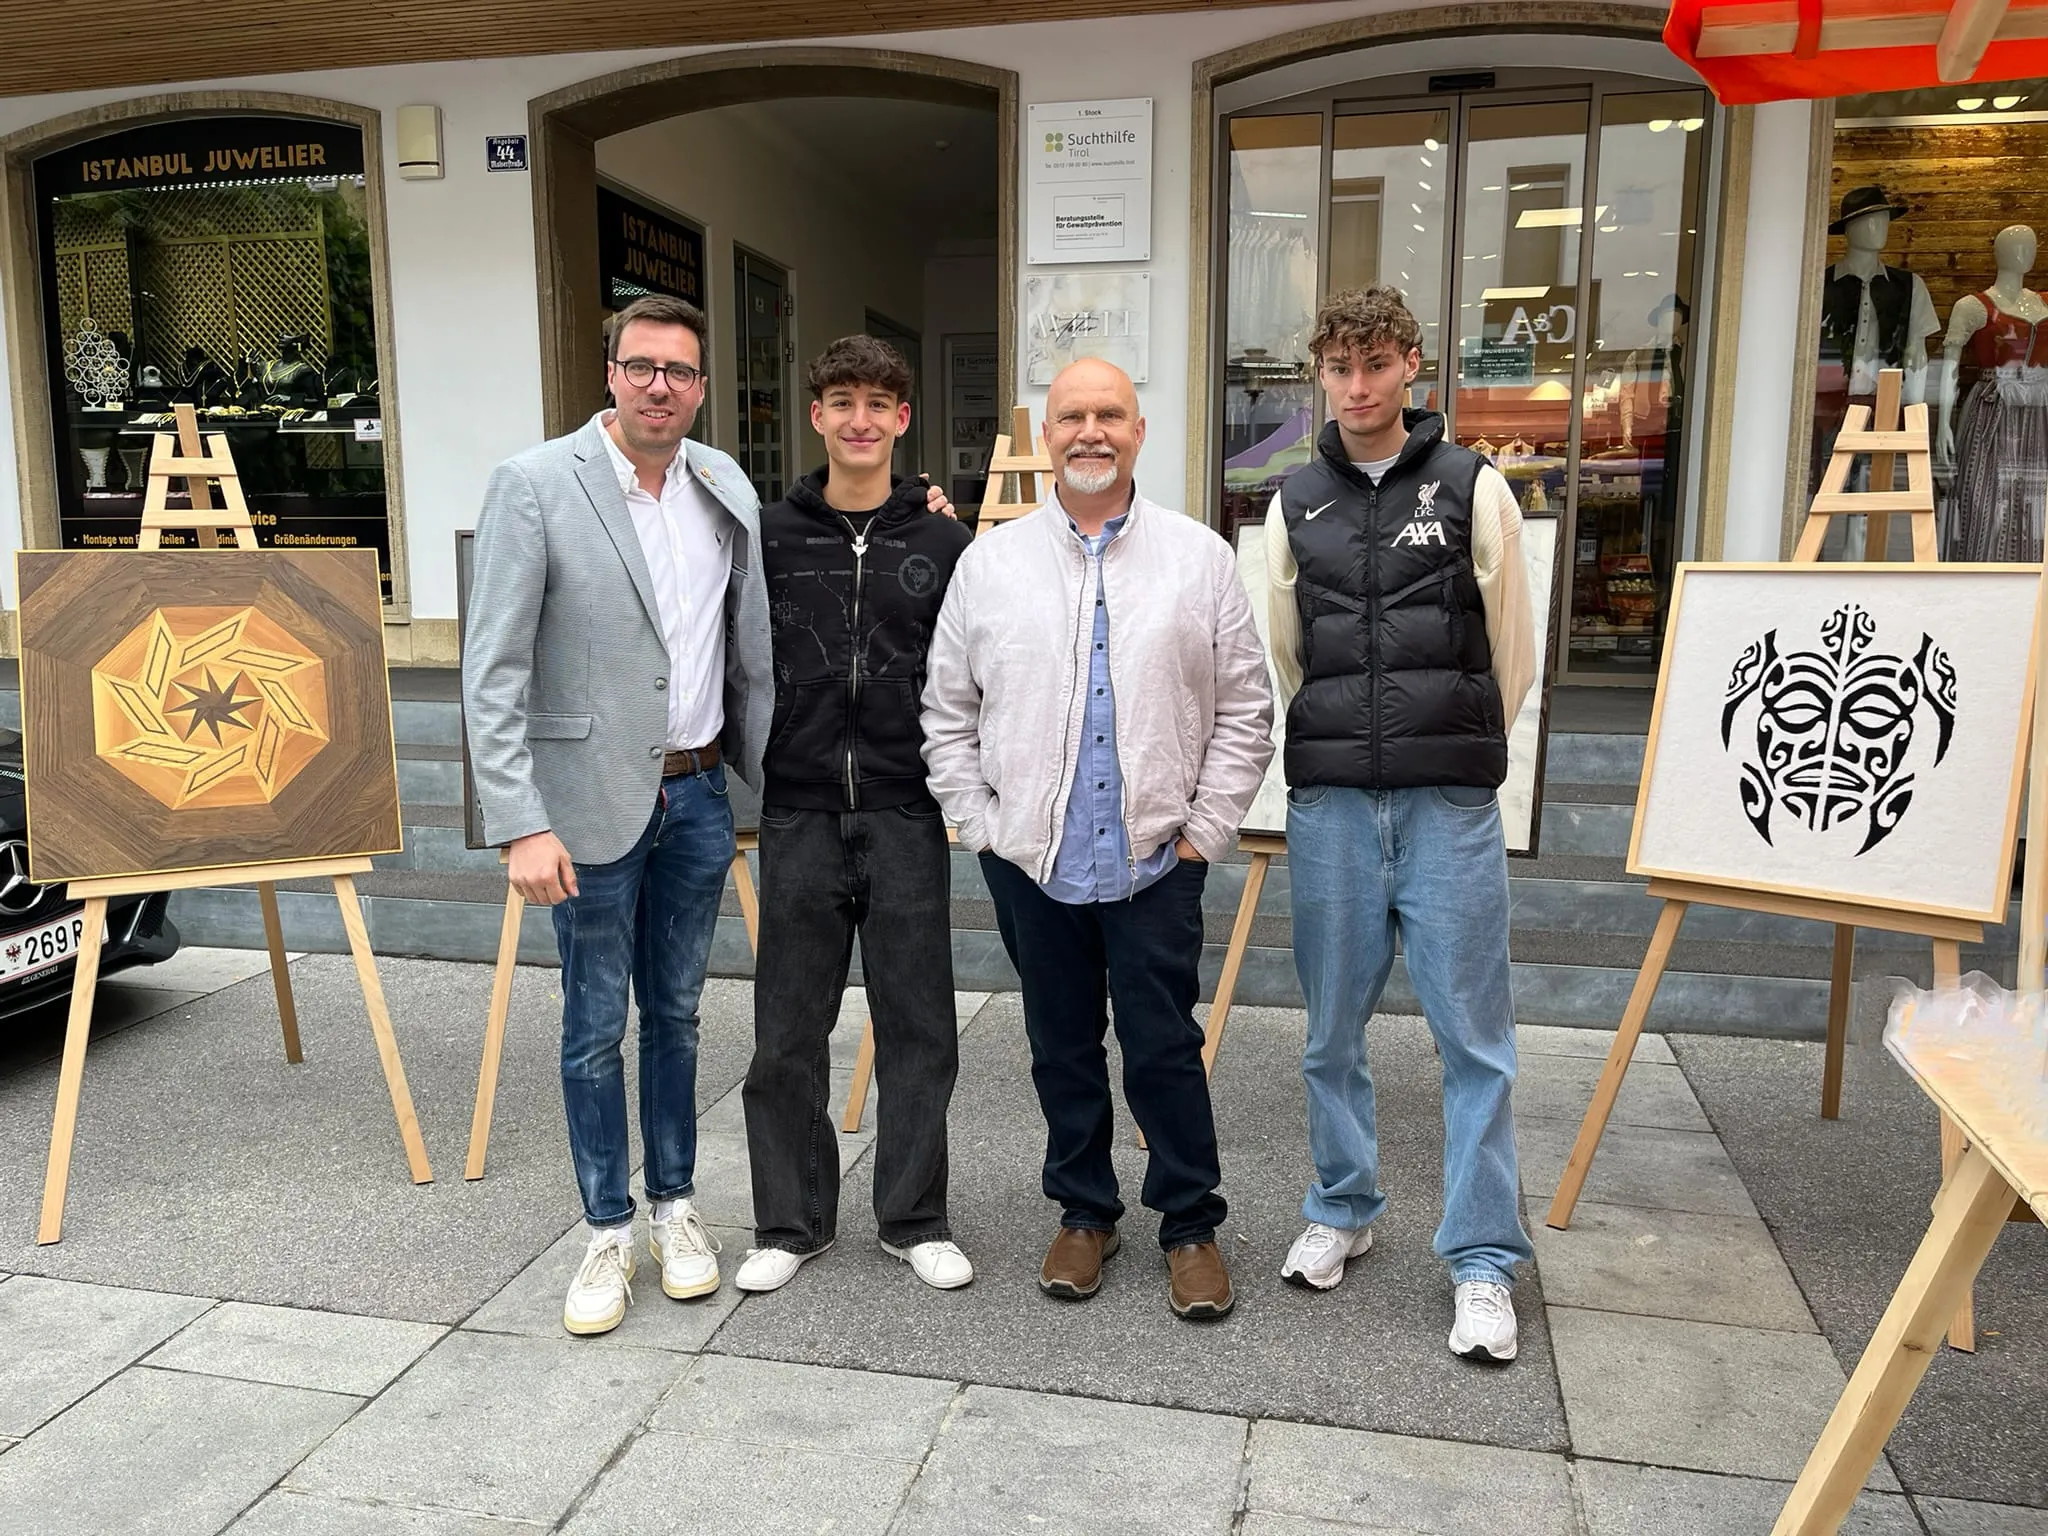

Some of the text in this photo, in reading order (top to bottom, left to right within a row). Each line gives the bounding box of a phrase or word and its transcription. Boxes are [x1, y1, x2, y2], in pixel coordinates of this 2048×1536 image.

[1068, 130, 1136, 146] Suchthilfe
[497, 145, 514, 160] 44
[1069, 148, 1090, 158] Tirol
[82, 143, 326, 182] ISTANBUL JUWELIER
[1056, 214, 1105, 222] Beratungsstelle
[1066, 219, 1123, 229] Gewaltprävention
[623, 211, 696, 268] ISTANBUL
[624, 247, 696, 297] JUWELIER
[250, 511, 277, 526] vice
[83, 534, 117, 547] Montage
[119, 536, 134, 544] von
[274, 533, 357, 547] Größenänderungen
[1390, 521, 1447, 547] AXA
[25, 920, 83, 965] 269 R
